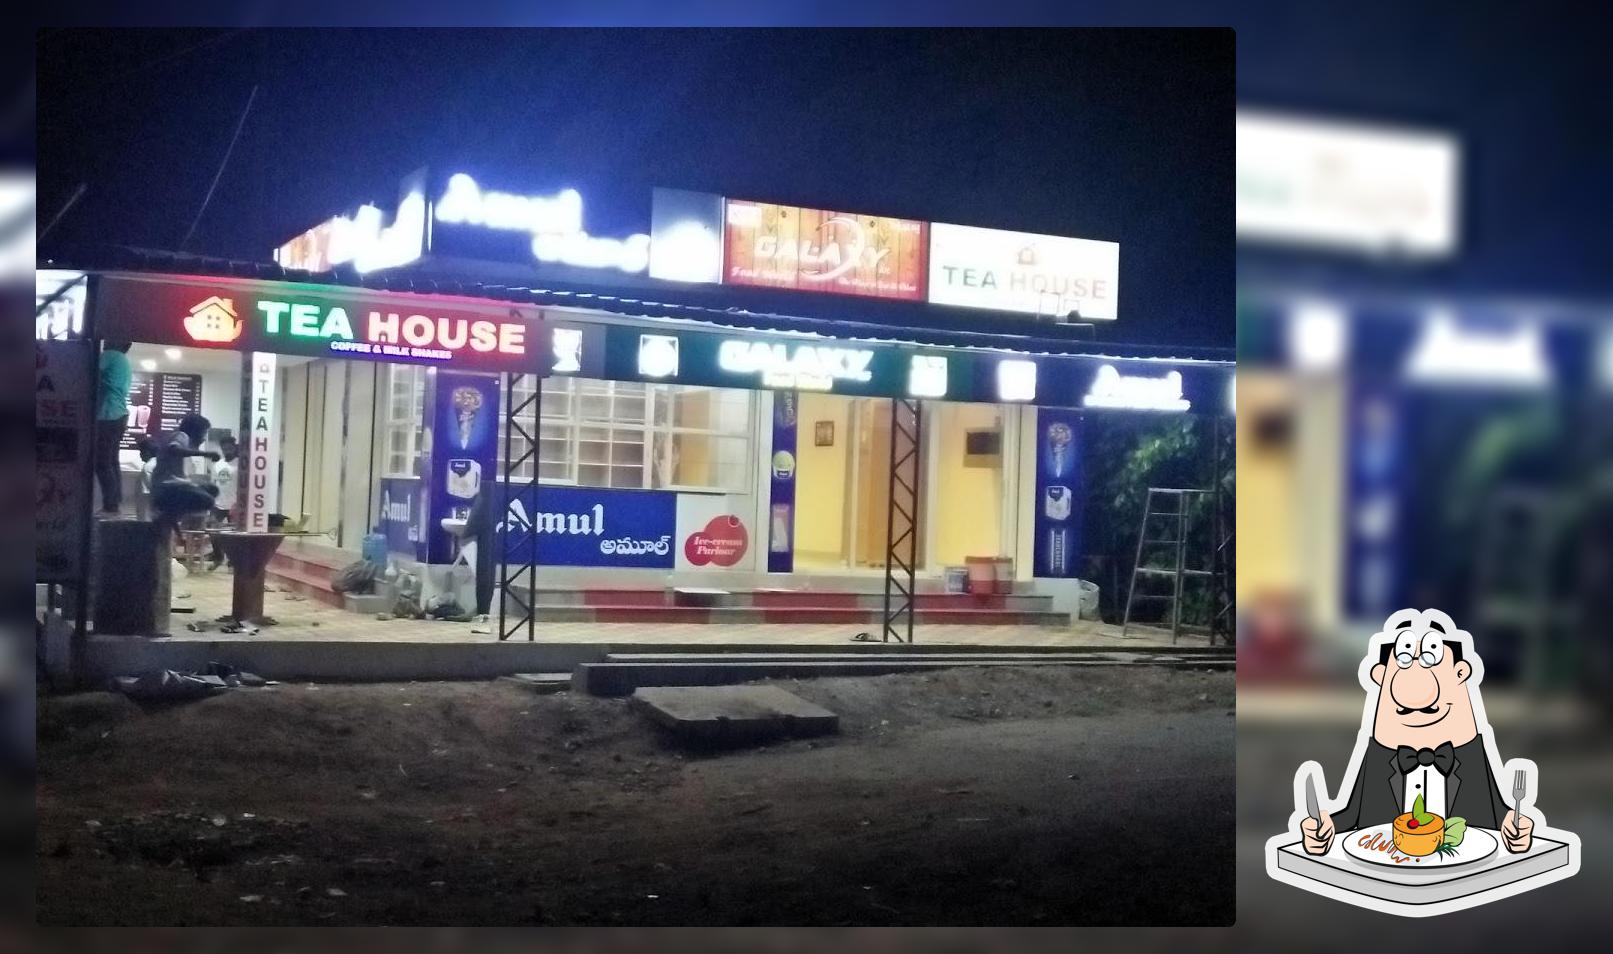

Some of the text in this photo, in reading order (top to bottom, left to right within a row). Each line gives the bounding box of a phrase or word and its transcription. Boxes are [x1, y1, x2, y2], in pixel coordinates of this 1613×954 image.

[942, 265, 998, 291] TEA
[1009, 271, 1108, 301] HOUSE
[257, 300, 526, 355] TEA HOUSE
[330, 341, 453, 361] COFFEE & MILK SHAKES
[719, 340, 874, 382] GALAXY
[381, 489, 411, 523] Amul
[496, 498, 605, 537] Amul
[696, 546, 737, 557] Parlour
